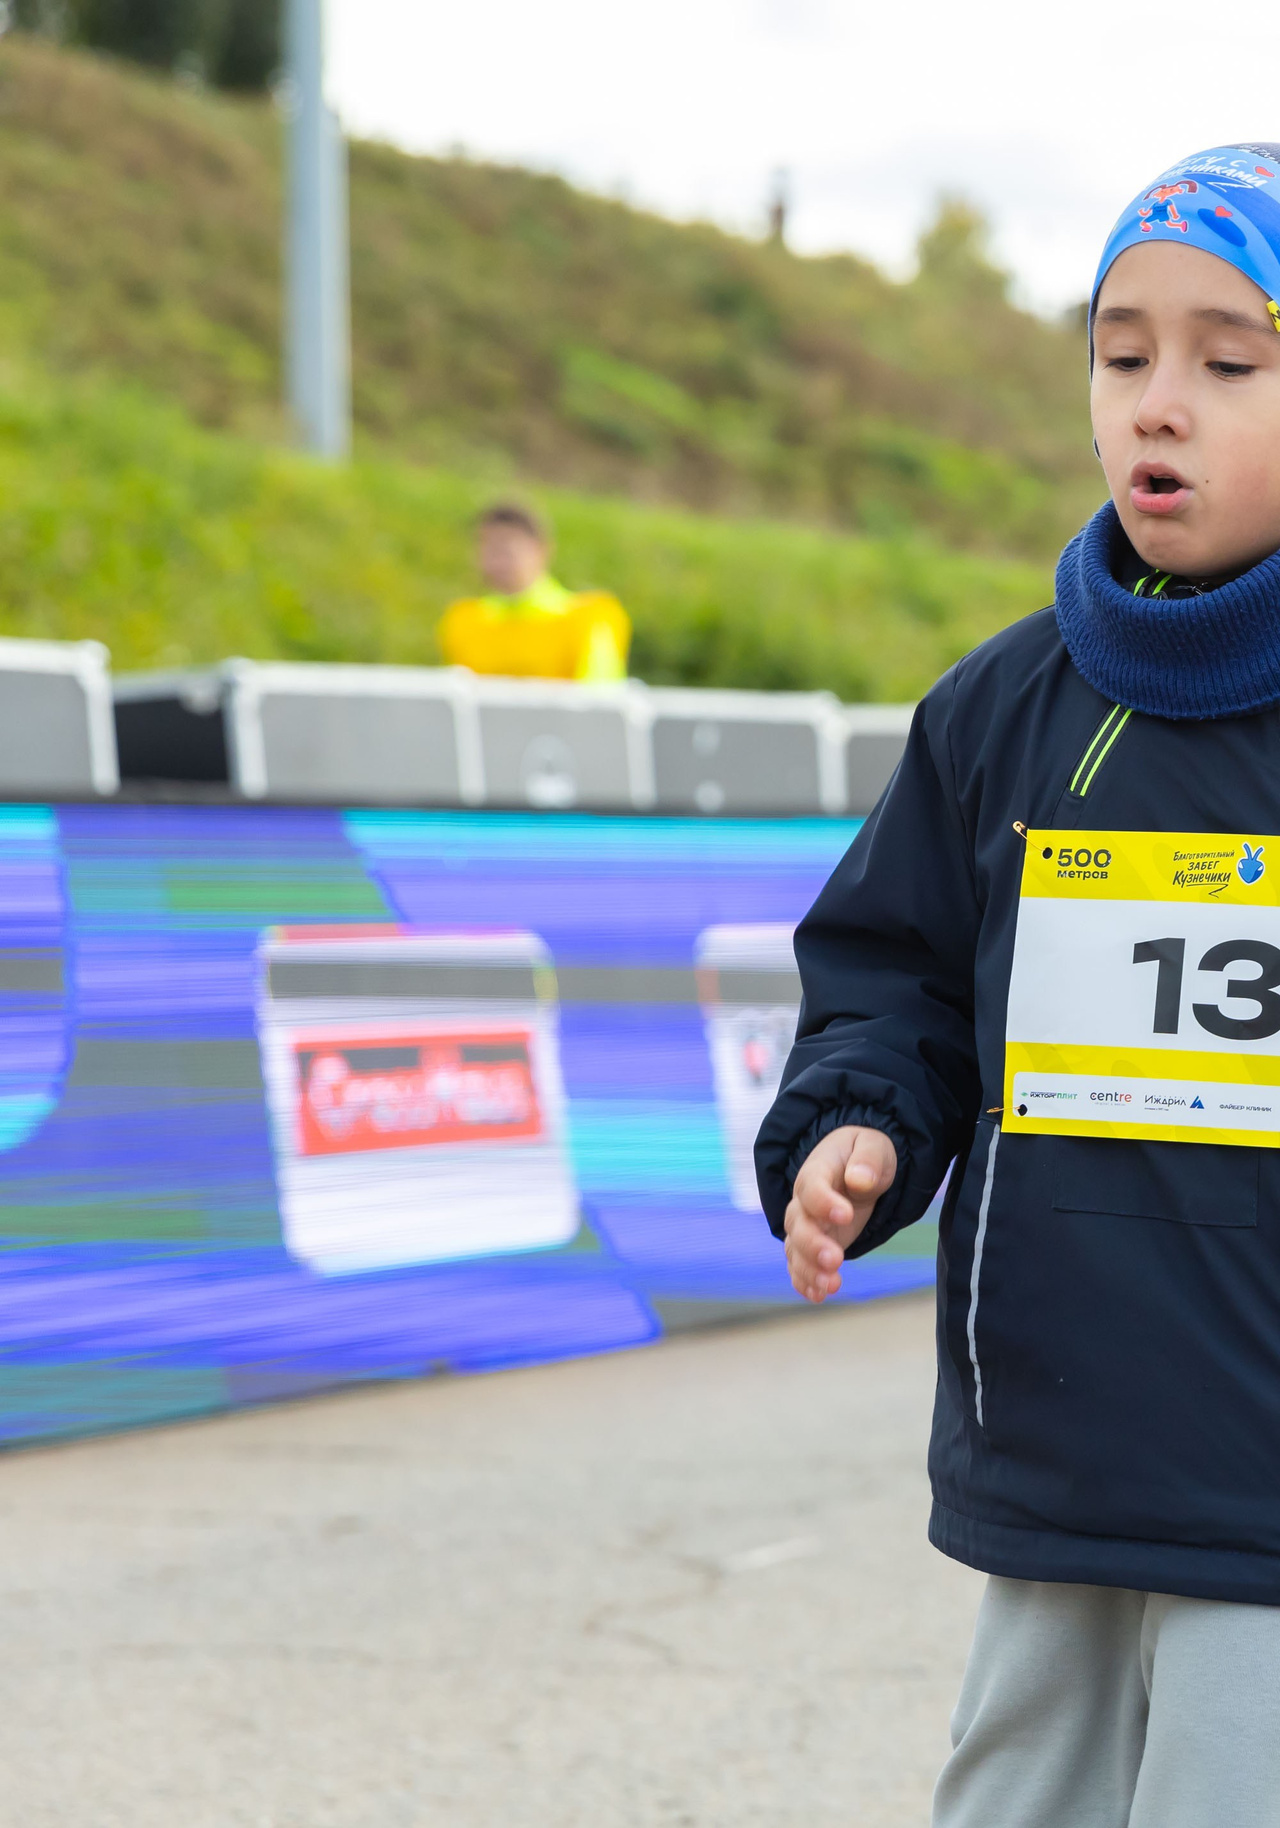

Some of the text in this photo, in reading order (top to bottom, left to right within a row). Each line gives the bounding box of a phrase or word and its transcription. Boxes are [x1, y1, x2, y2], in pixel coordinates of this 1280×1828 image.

[1057, 848, 1112, 868] 500
[1057, 870, 1108, 880] метров
[1089, 1091, 1132, 1103] centre
